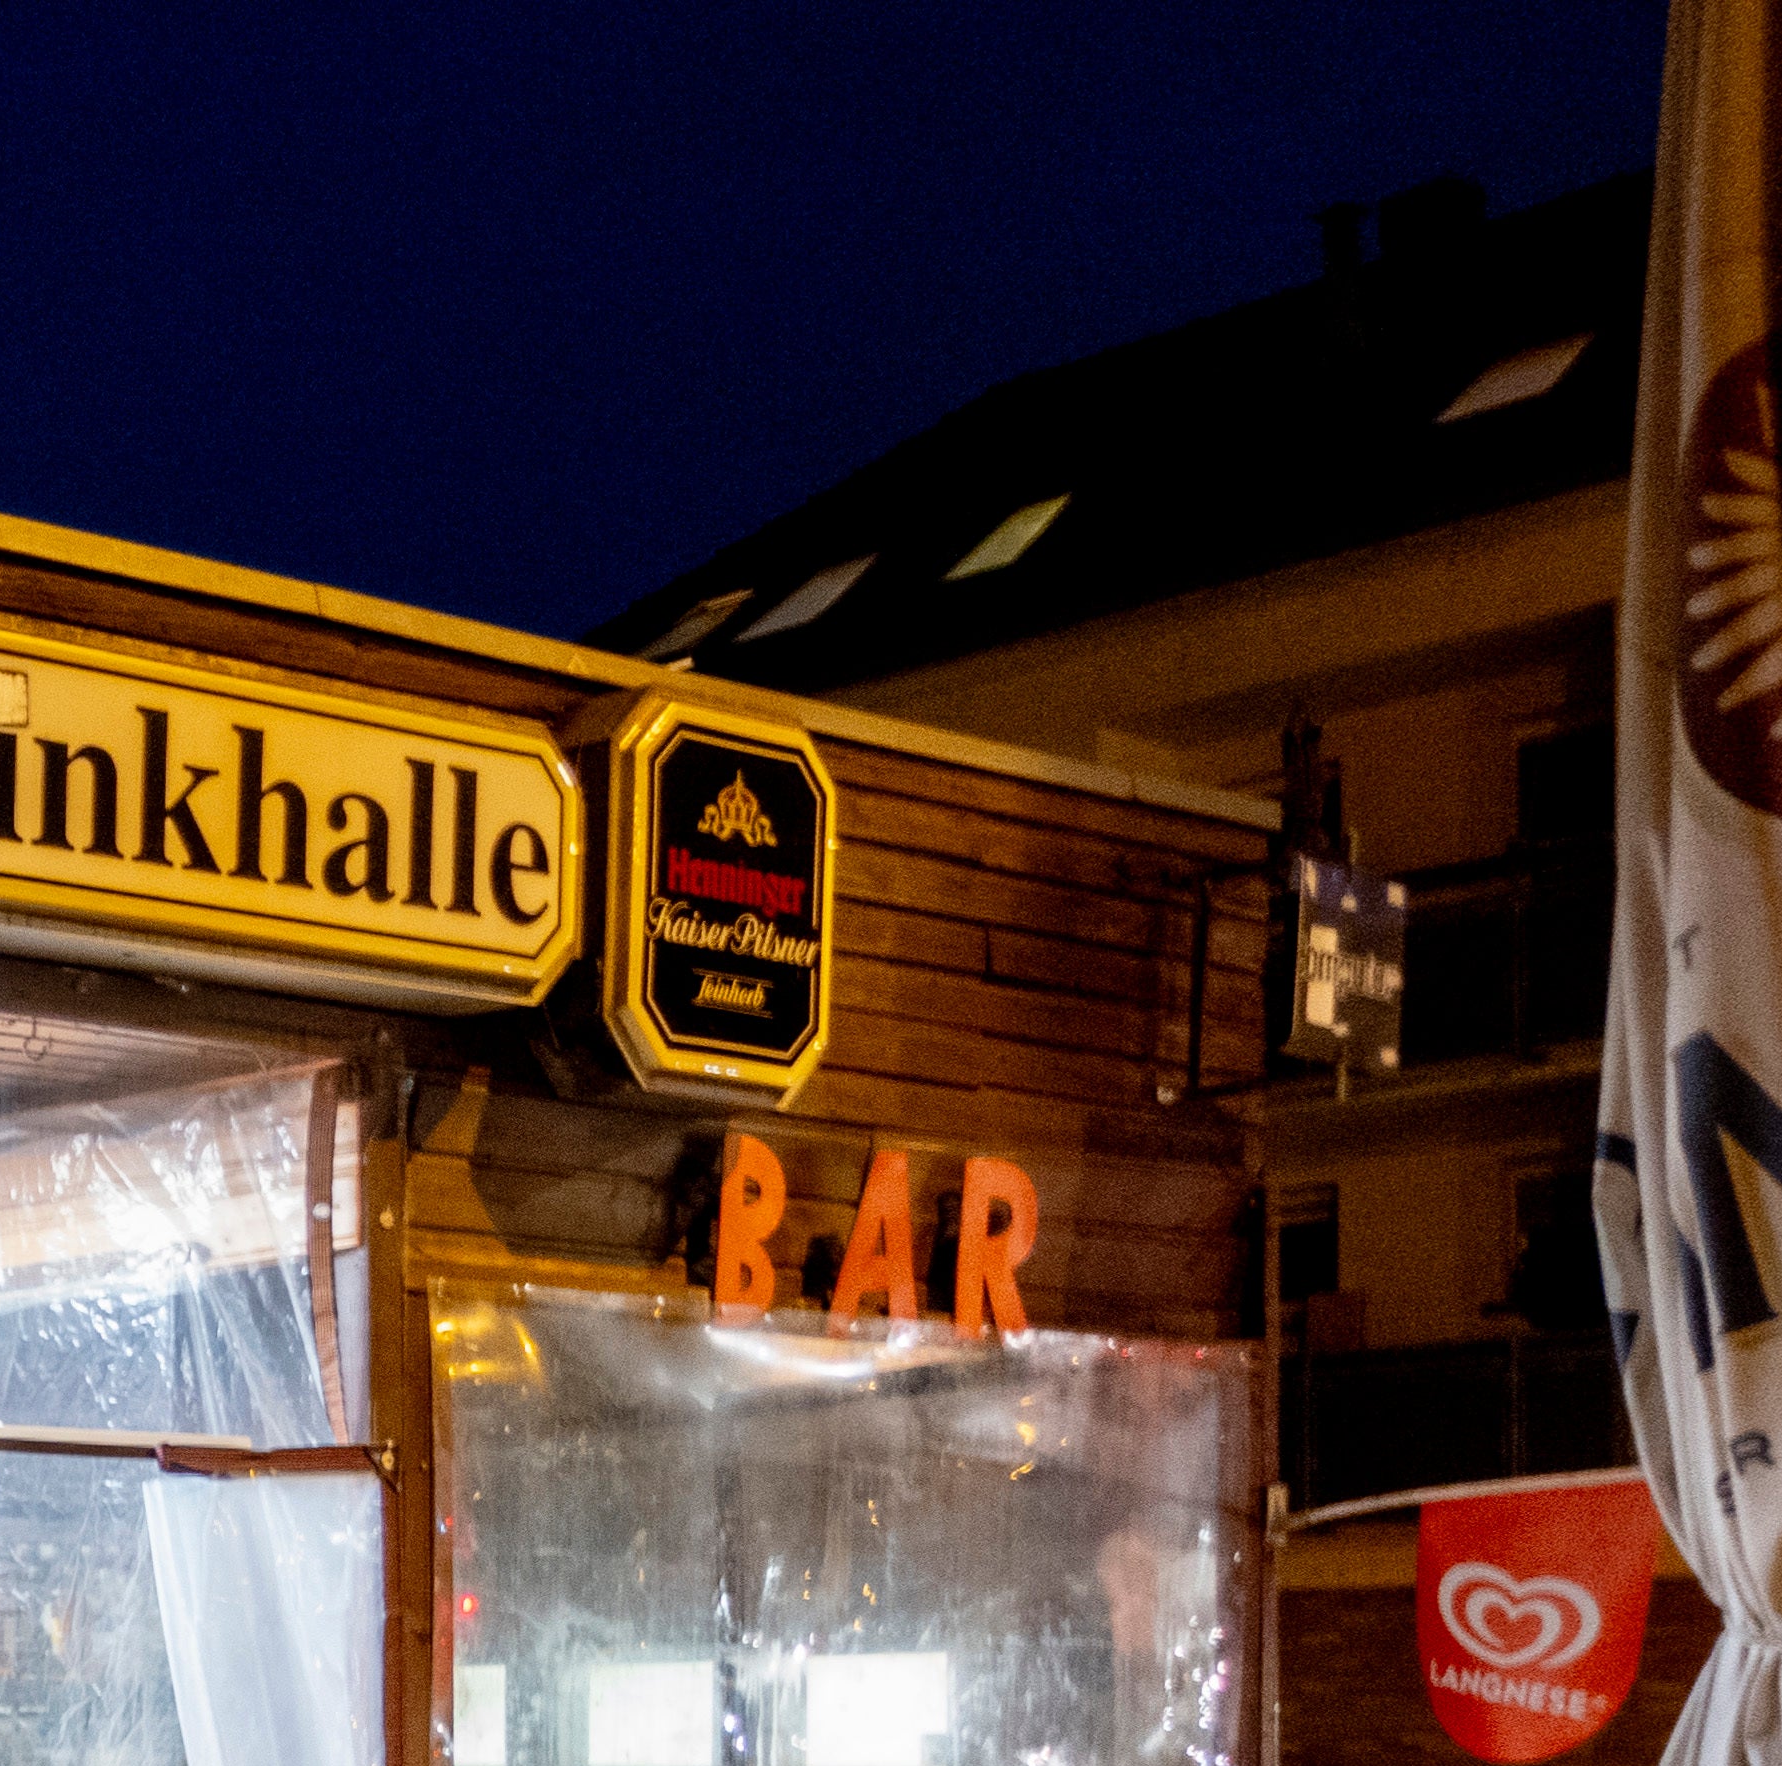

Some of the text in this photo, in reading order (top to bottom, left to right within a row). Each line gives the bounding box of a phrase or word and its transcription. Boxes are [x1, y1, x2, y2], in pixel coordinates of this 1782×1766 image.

[667, 846, 806, 917] Henninger
[644, 896, 821, 967] Kaiser Pilsner
[696, 974, 767, 1008] feinherb
[714, 1134, 1037, 1341] BAR
[1428, 1658, 1590, 1723] LANGNESE
